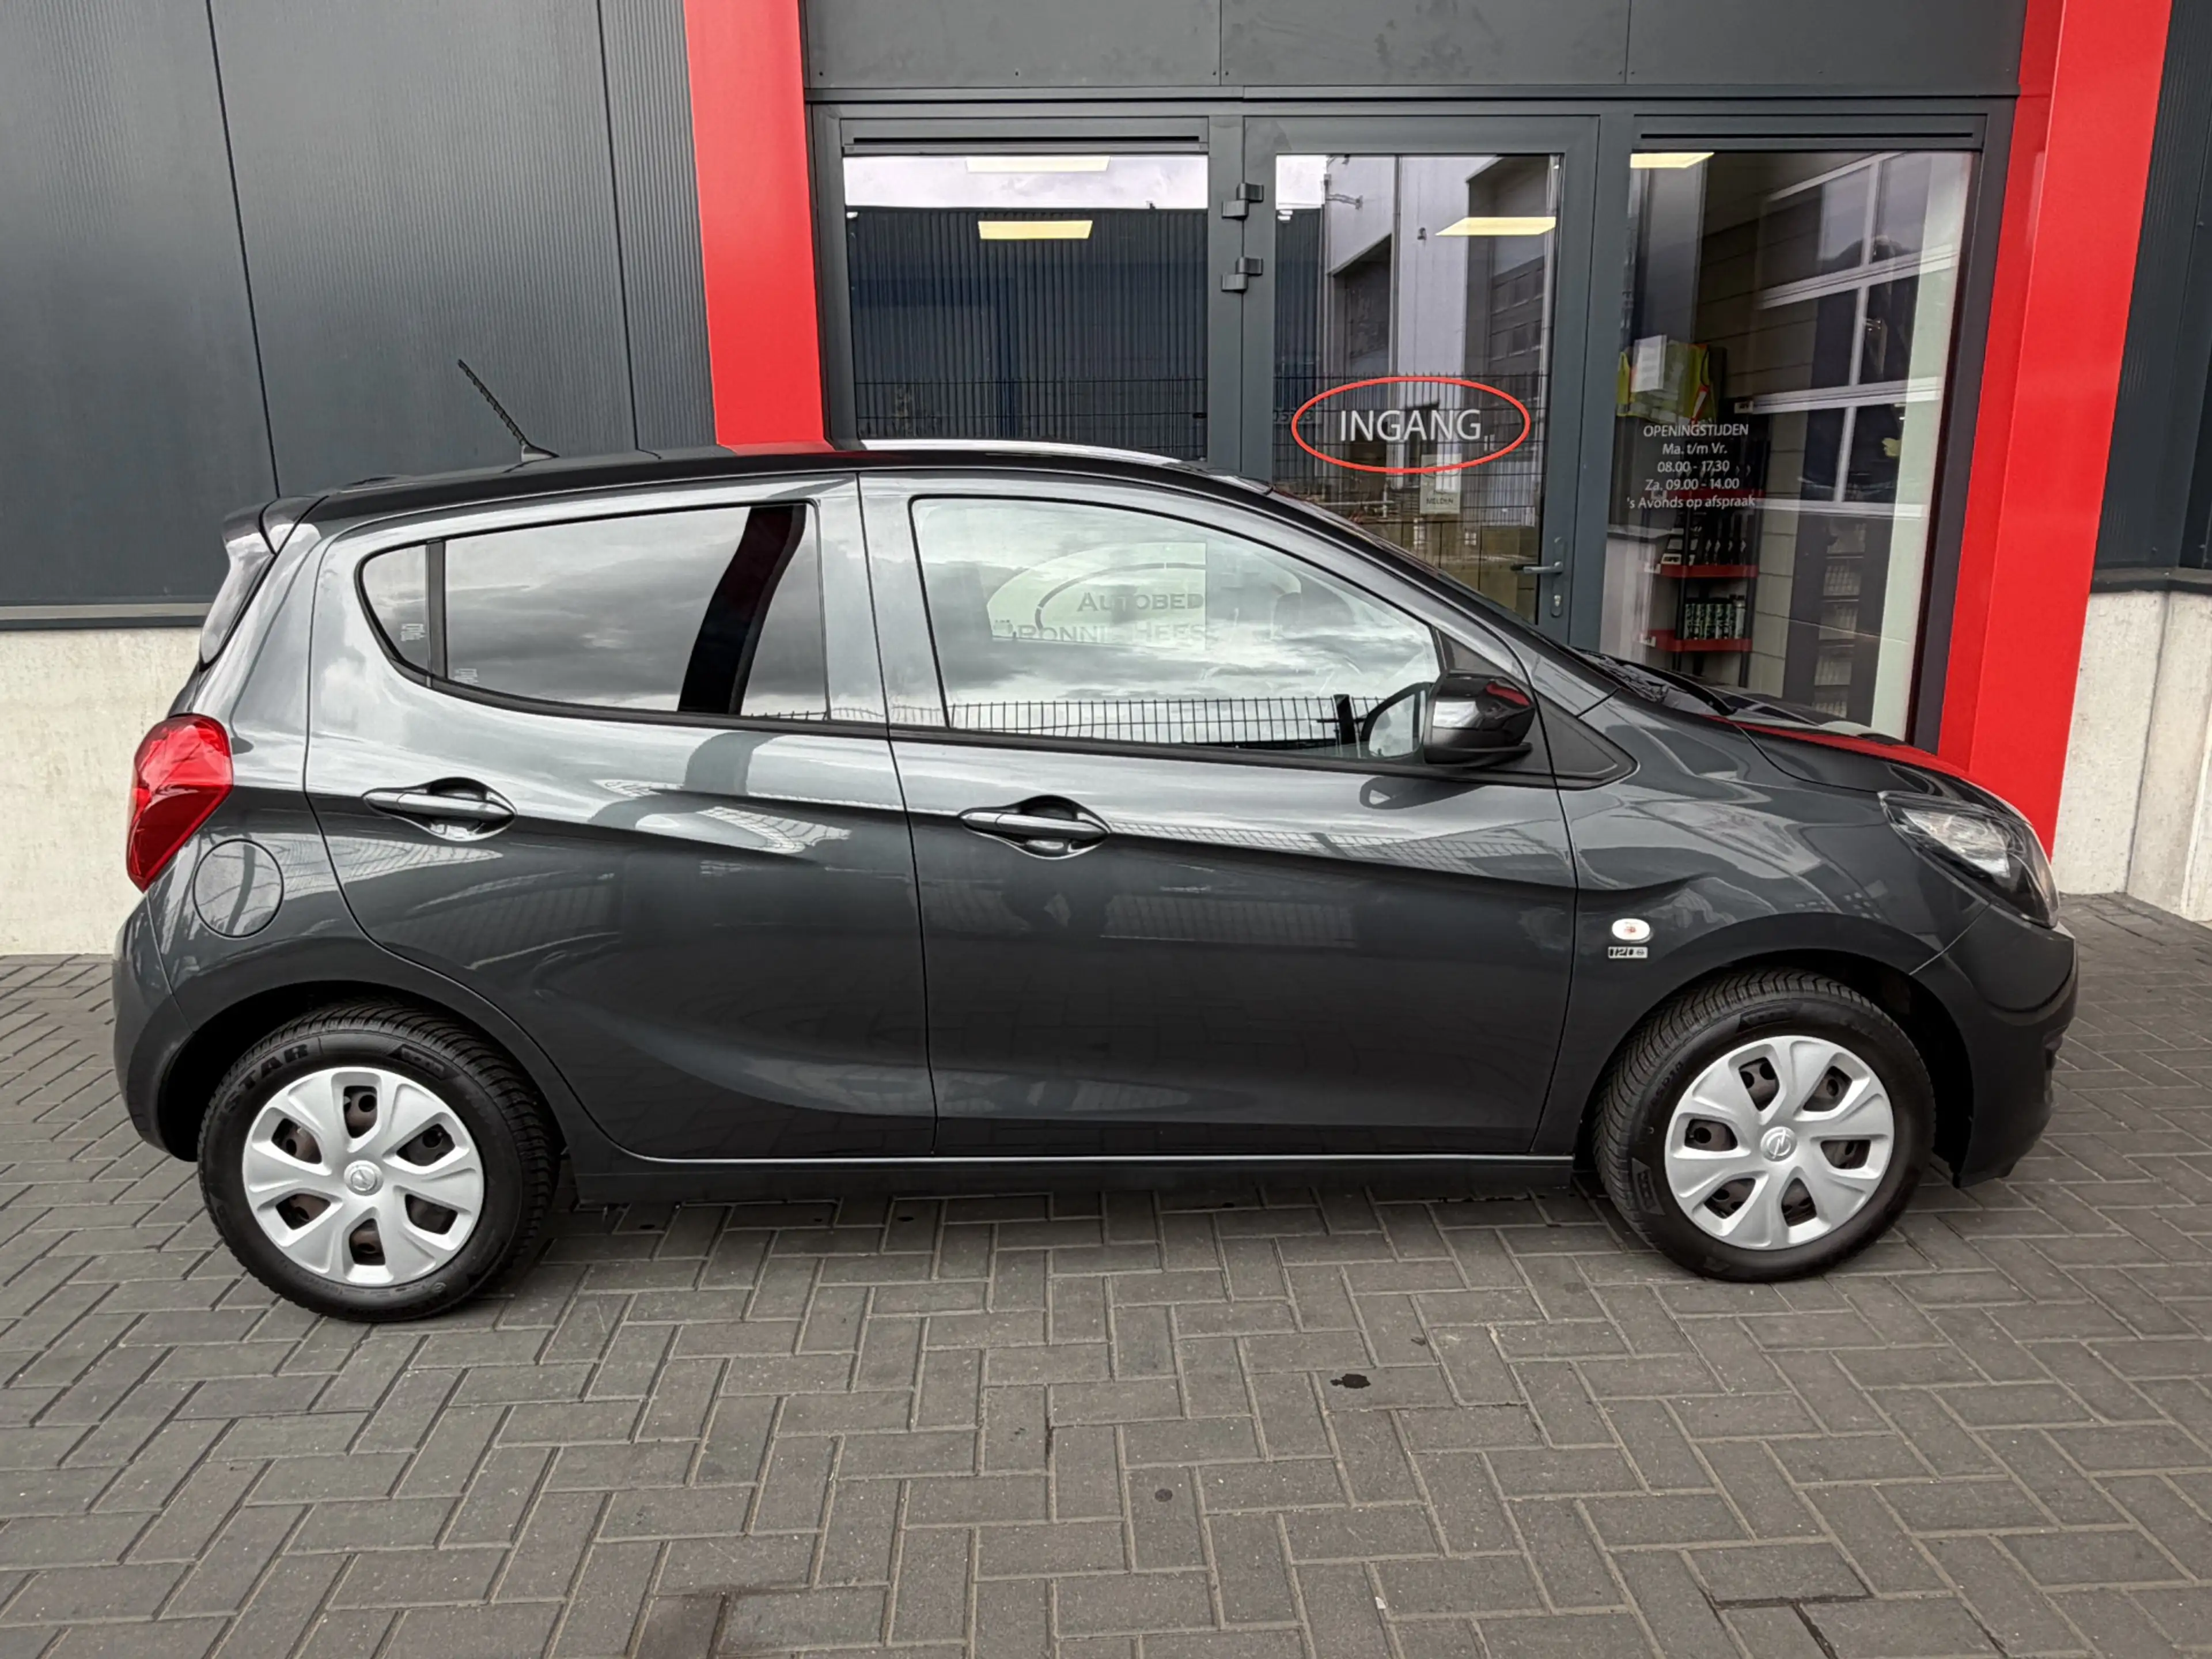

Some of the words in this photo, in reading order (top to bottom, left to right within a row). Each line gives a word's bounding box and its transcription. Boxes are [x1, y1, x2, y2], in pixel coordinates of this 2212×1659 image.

[1340, 409, 1481, 441] INGANG
[1643, 423, 1749, 437] OPENINGSTIJDEN
[1662, 443, 1684, 455] Ma.
[1687, 442, 1708, 455] t/m
[1711, 442, 1728, 454] Vr.
[1657, 461, 1691, 473] 08.00
[1645, 479, 1663, 491] Za.
[1666, 478, 1699, 490] 09.00
[1710, 478, 1740, 490] 14.00
[1626, 497, 1635, 509] 's
[1638, 497, 1684, 509] Avonds
[1686, 499, 1702, 510] op
[1705, 494, 1756, 510] afspraak
